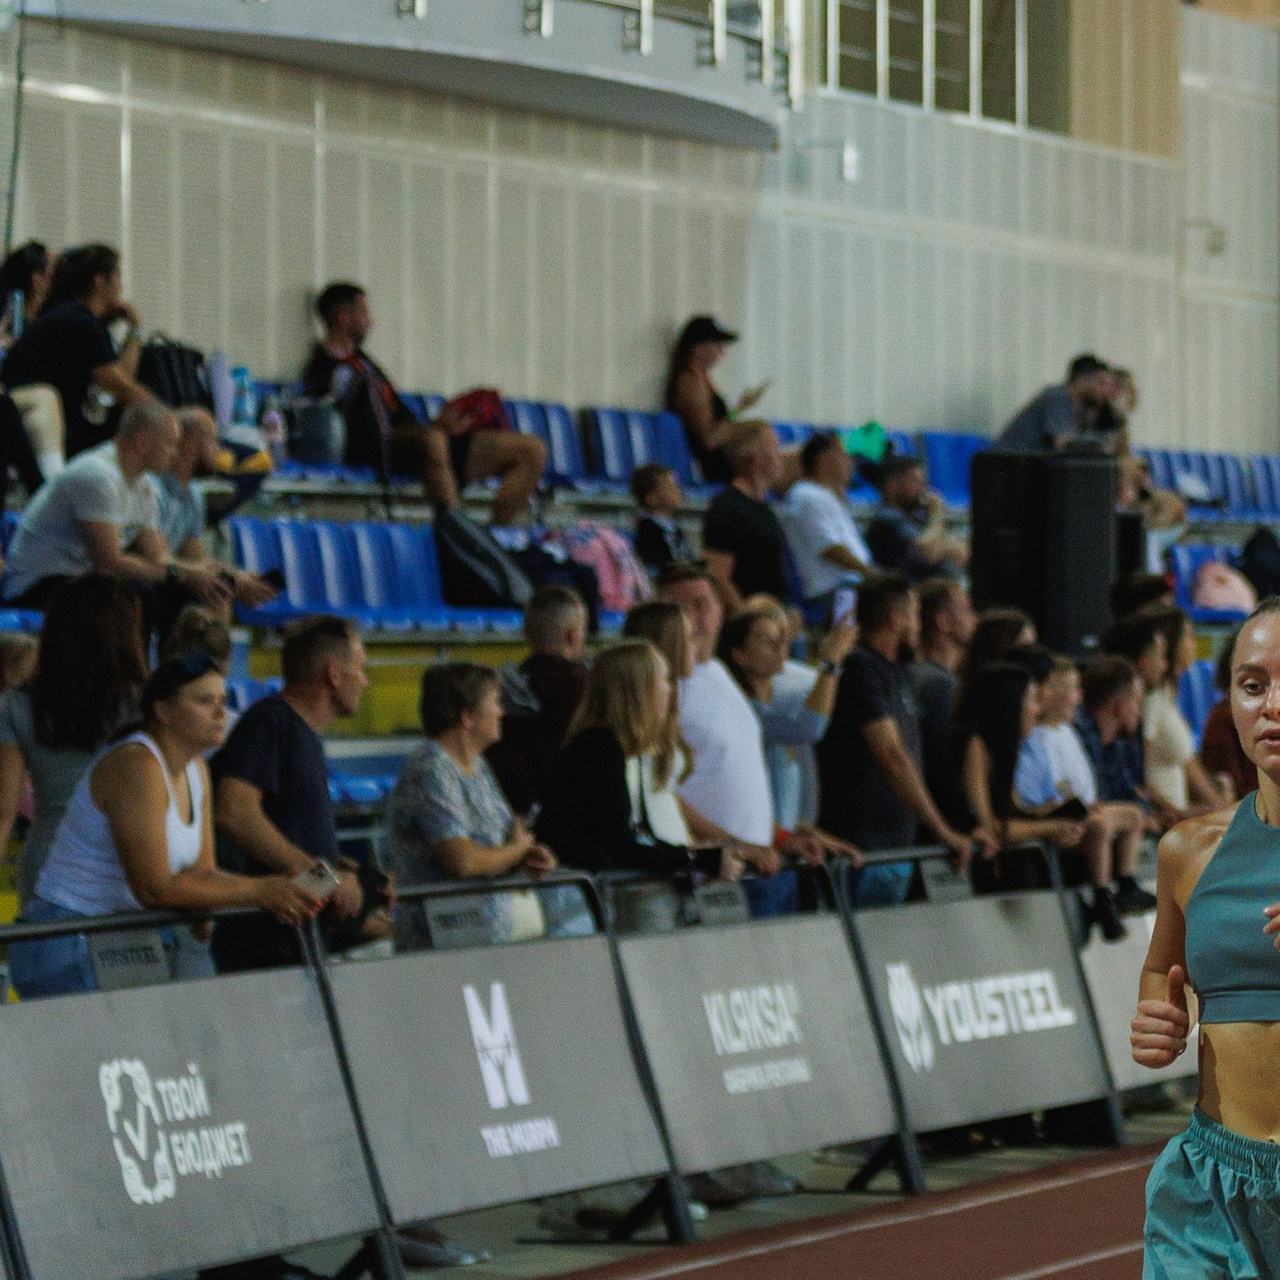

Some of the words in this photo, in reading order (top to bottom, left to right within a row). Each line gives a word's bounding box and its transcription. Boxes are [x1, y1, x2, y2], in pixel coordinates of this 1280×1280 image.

[924, 969, 1077, 1046] YOUSTEEL
[155, 1062, 211, 1122] ТВОЙ
[170, 1120, 252, 1179] БЮДЖЕТ
